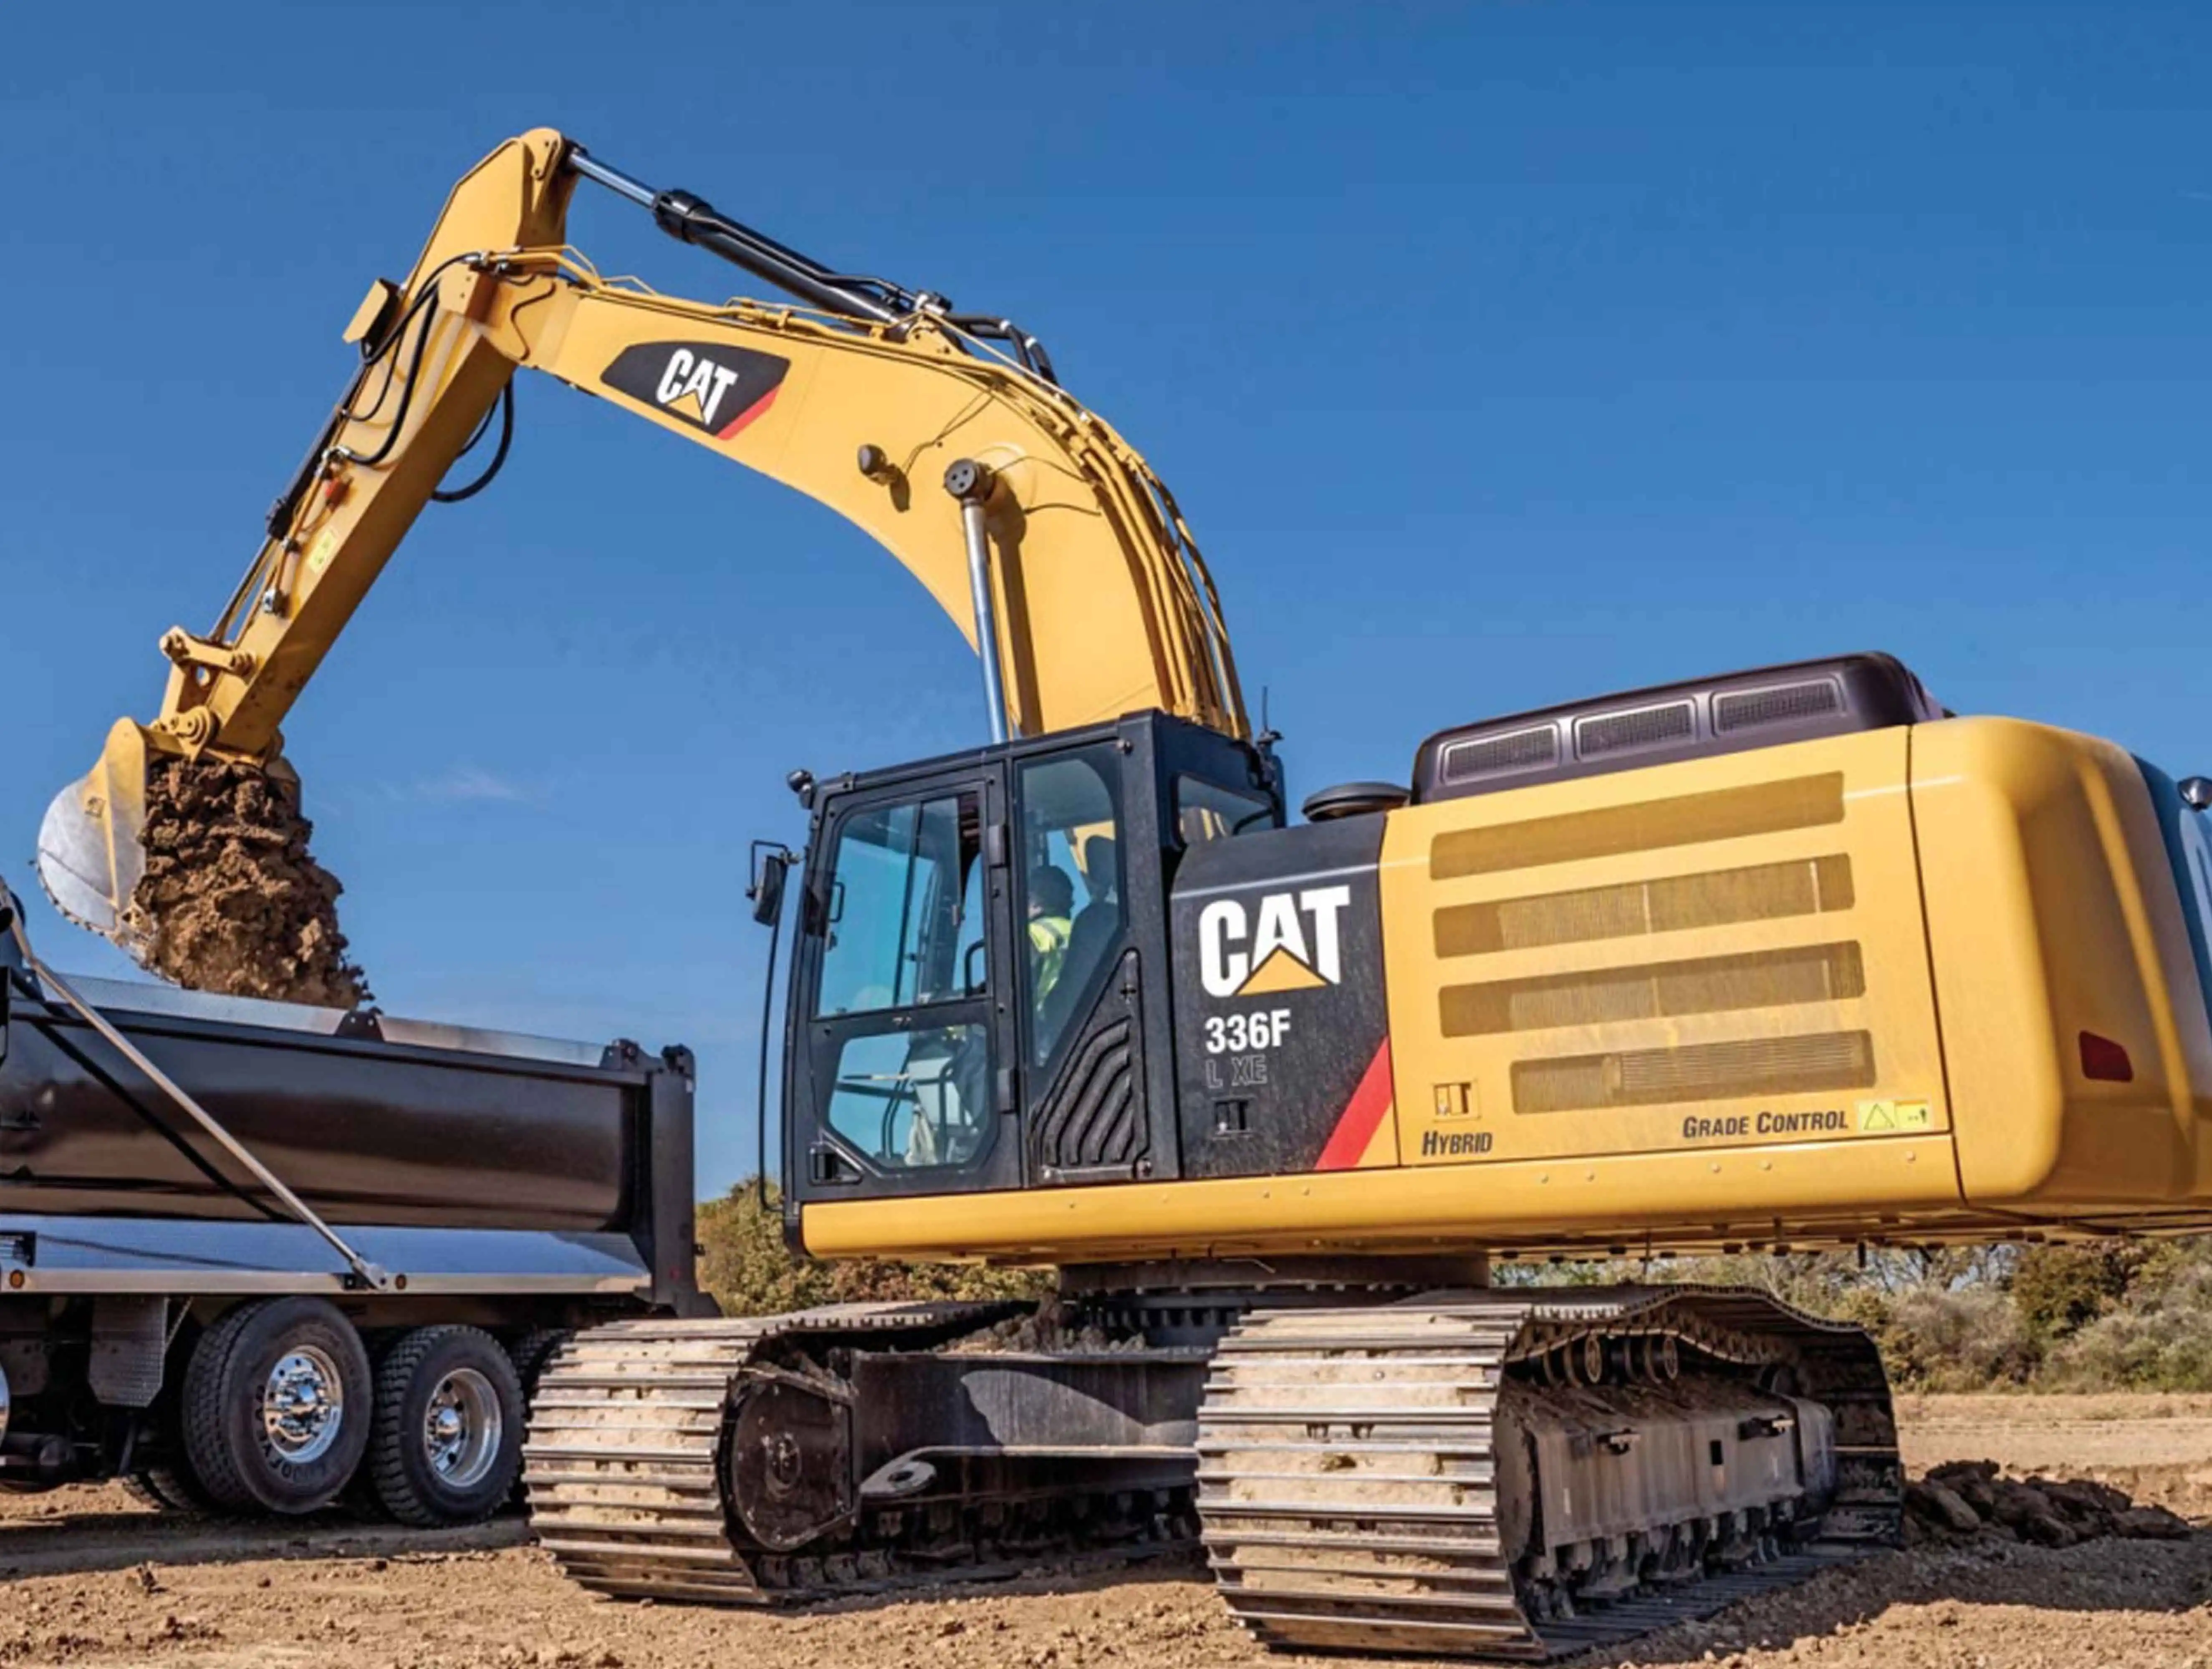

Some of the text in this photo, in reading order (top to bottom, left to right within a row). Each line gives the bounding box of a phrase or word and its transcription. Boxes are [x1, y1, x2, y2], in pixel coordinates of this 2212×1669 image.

[656, 348, 738, 425] CAT
[1199, 885, 1351, 997] CAT
[1204, 1008, 1291, 1054] 336F
[1205, 1054, 1267, 1089] L XE
[1683, 1111, 1848, 1139] GRADE CONTROL
